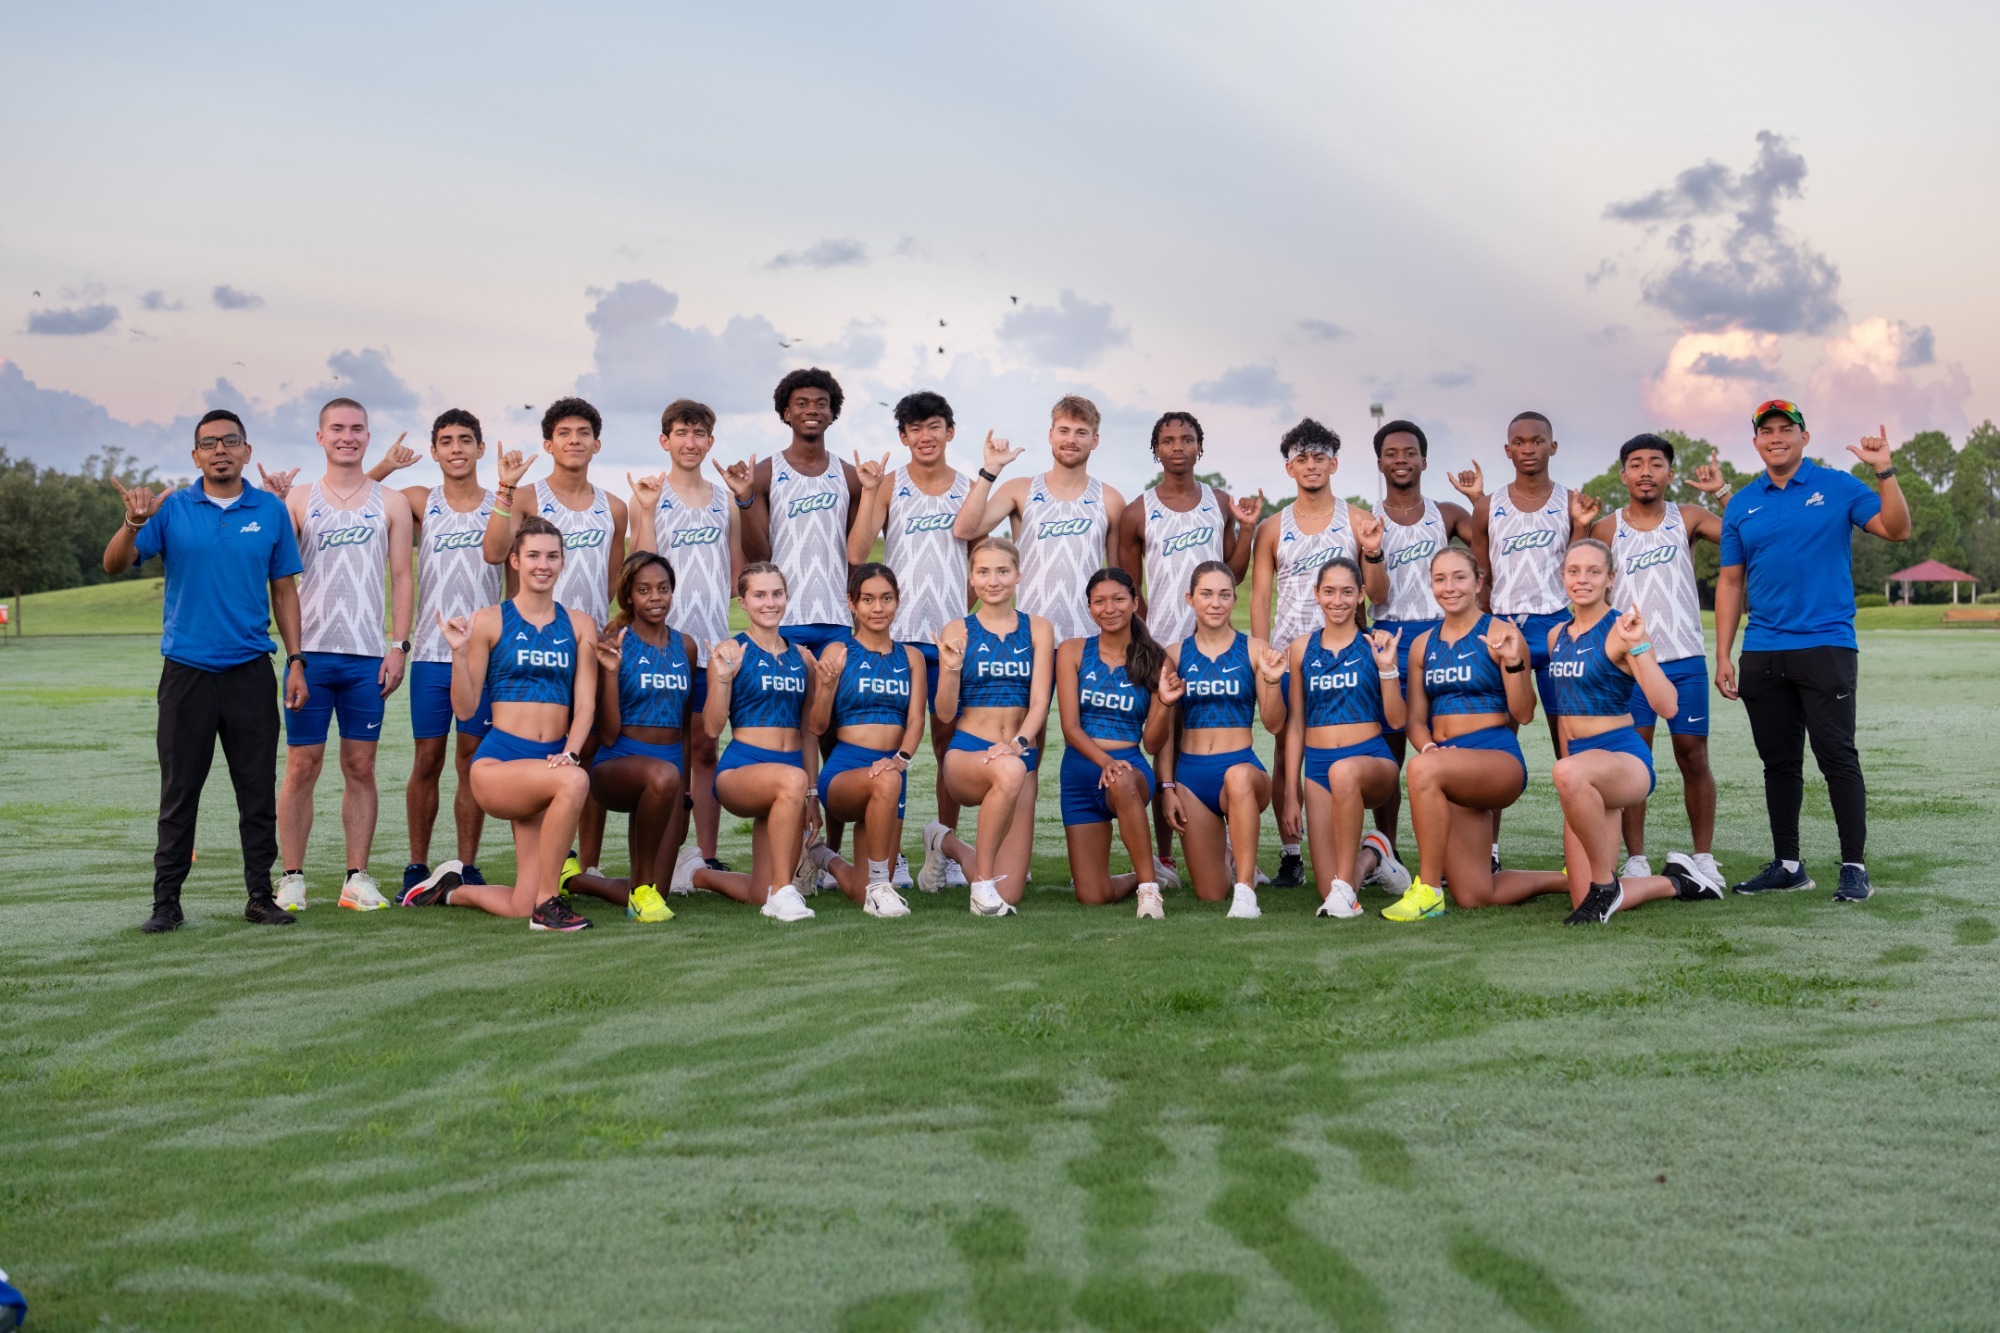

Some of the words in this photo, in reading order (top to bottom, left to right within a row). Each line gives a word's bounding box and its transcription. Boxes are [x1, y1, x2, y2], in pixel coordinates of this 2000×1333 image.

[788, 493, 838, 518] FGCU
[317, 526, 375, 551] FGCU
[671, 526, 721, 548] FGCU
[1038, 518, 1092, 539] FGCU
[1163, 527, 1214, 556] FGCU
[1502, 529, 1556, 555] FGCU
[1389, 540, 1436, 570] FGCU
[1626, 545, 1677, 575] FGCU
[517, 650, 569, 668] FGCU
[978, 661, 1031, 677] FGCU
[1549, 661, 1584, 678] FGCU
[640, 673, 688, 690] FGCU
[761, 675, 805, 693] FGCU
[1309, 672, 1358, 692] FGCU
[1425, 665, 1472, 686] FGCU
[858, 678, 910, 696] FGCU
[1186, 680, 1239, 697] FGCU
[1080, 689, 1134, 712] FGCU
